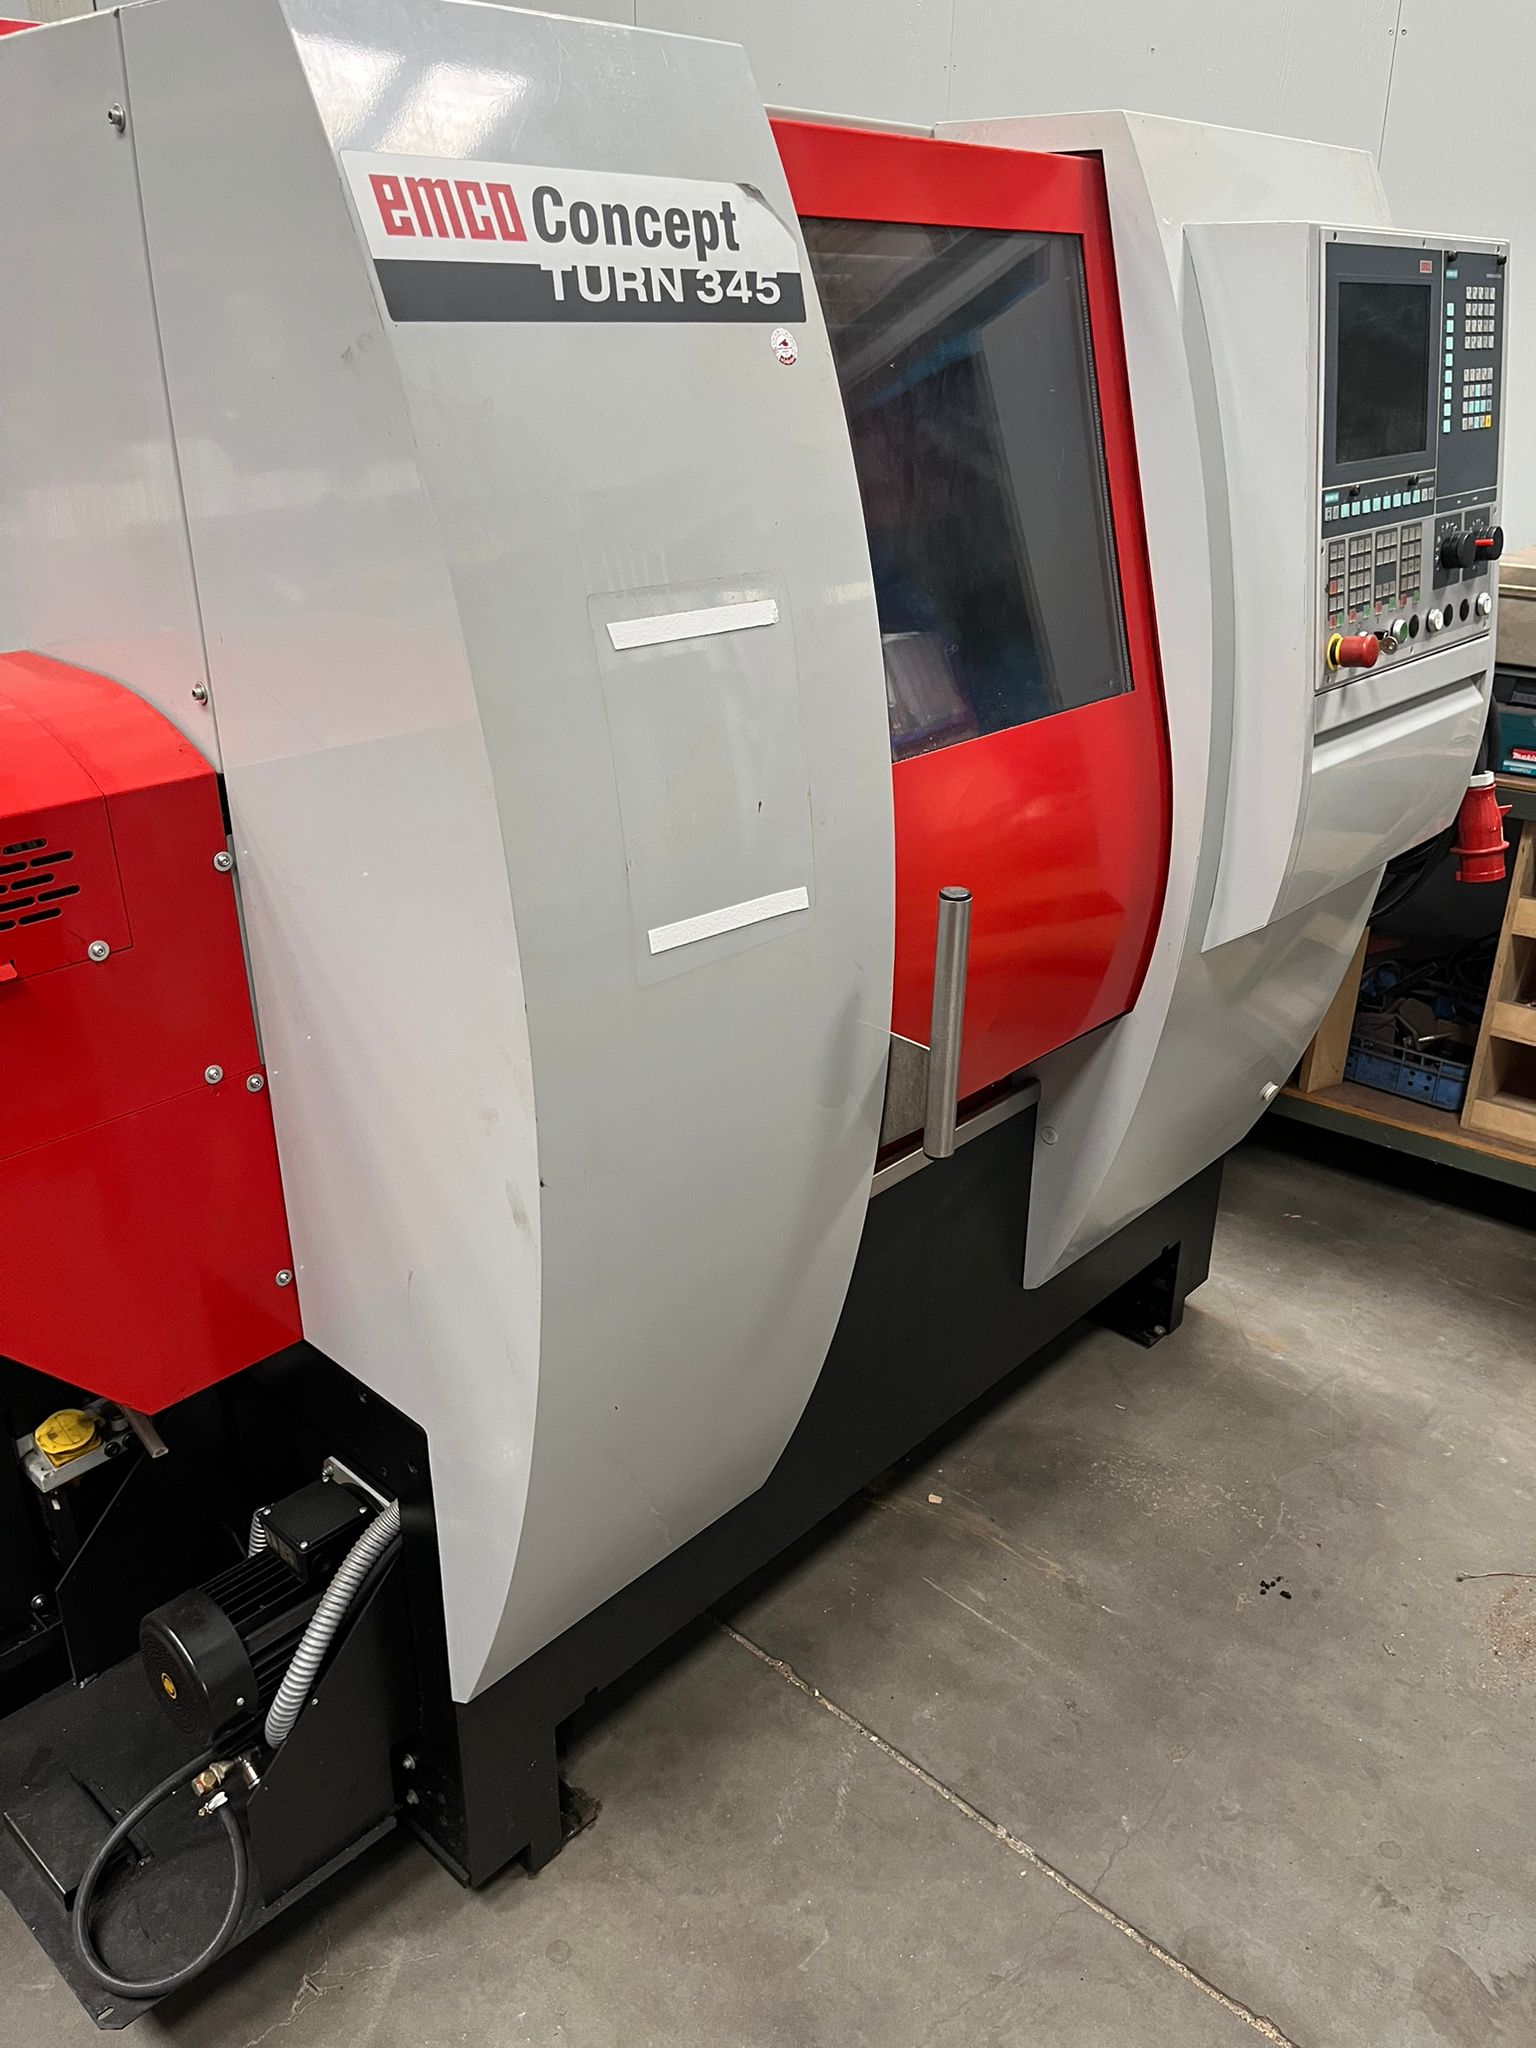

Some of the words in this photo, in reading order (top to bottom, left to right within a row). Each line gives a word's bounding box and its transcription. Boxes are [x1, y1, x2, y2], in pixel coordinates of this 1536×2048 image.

[532, 185, 740, 262] Concept
[540, 264, 685, 303] TURN
[696, 269, 782, 305] 345
